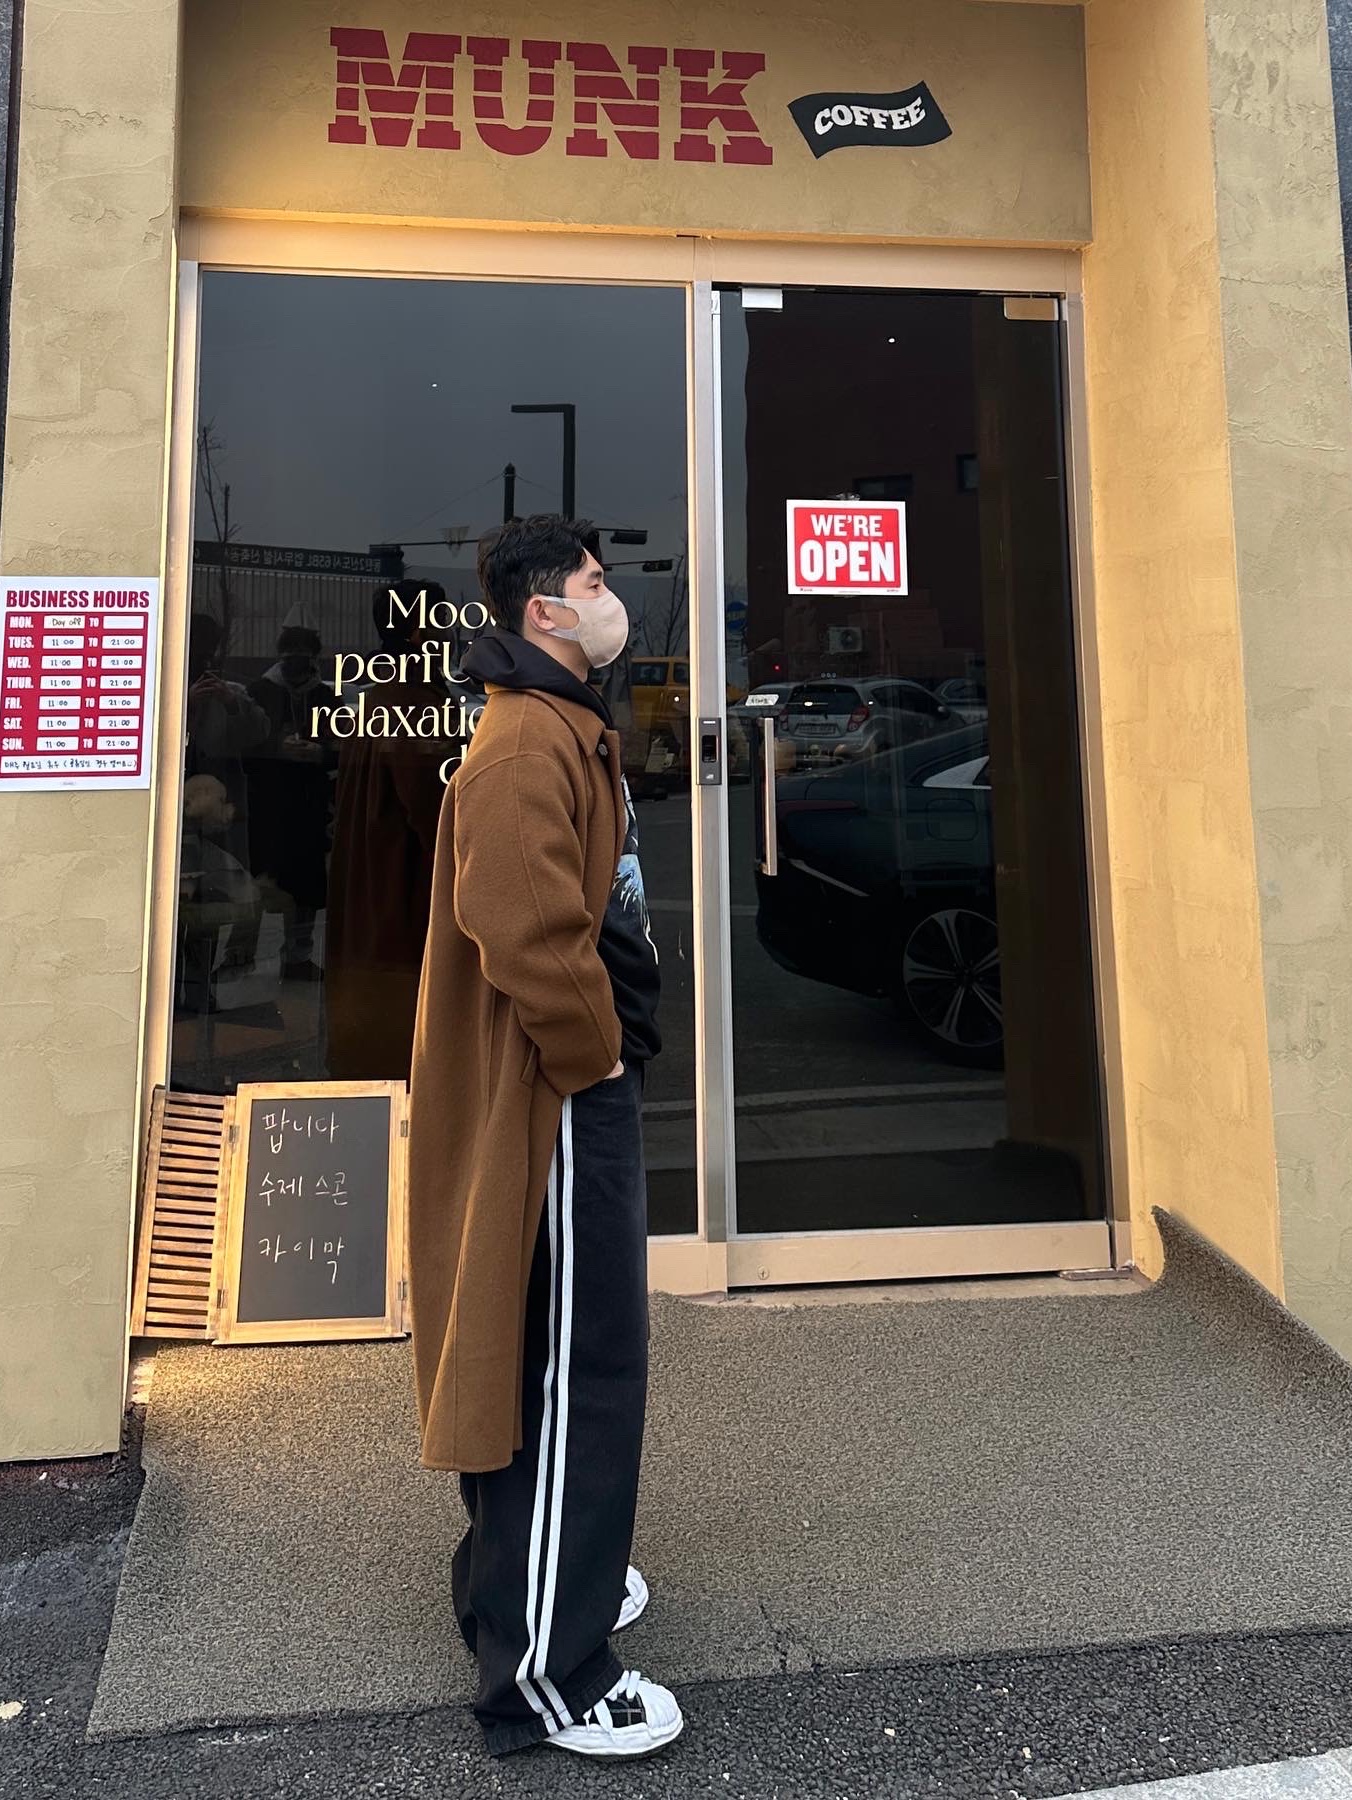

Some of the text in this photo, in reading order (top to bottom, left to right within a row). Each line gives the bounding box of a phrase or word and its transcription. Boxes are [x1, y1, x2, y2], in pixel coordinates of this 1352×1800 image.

[328, 26, 925, 165] MUNK COFFEE
[811, 514, 883, 537] WE'RE
[799, 540, 895, 582] OPEN
[6, 590, 149, 608] BUSINESS HOURS
[386, 589, 497, 629] Moo
[9, 616, 34, 628] MON.
[52, 618, 65, 628] Day
[89, 616, 99, 628] TO
[8, 636, 34, 648] TUES.
[88, 637, 98, 648] TO
[7, 656, 31, 669] WED.
[87, 657, 97, 668] TO
[6, 677, 34, 689] THUR.
[86, 677, 96, 688] TO
[5, 697, 22, 709] FRI.
[85, 697, 95, 708] TO
[3, 717, 22, 729] SAT.
[84, 717, 94, 728] TO
[2, 737, 24, 750] SUN.
[83, 738, 93, 748] TO
[262, 1108, 339, 1154] 팝니다
[259, 1171, 348, 1207] 수제 스콘
[259, 1235, 345, 1284] 카이막
